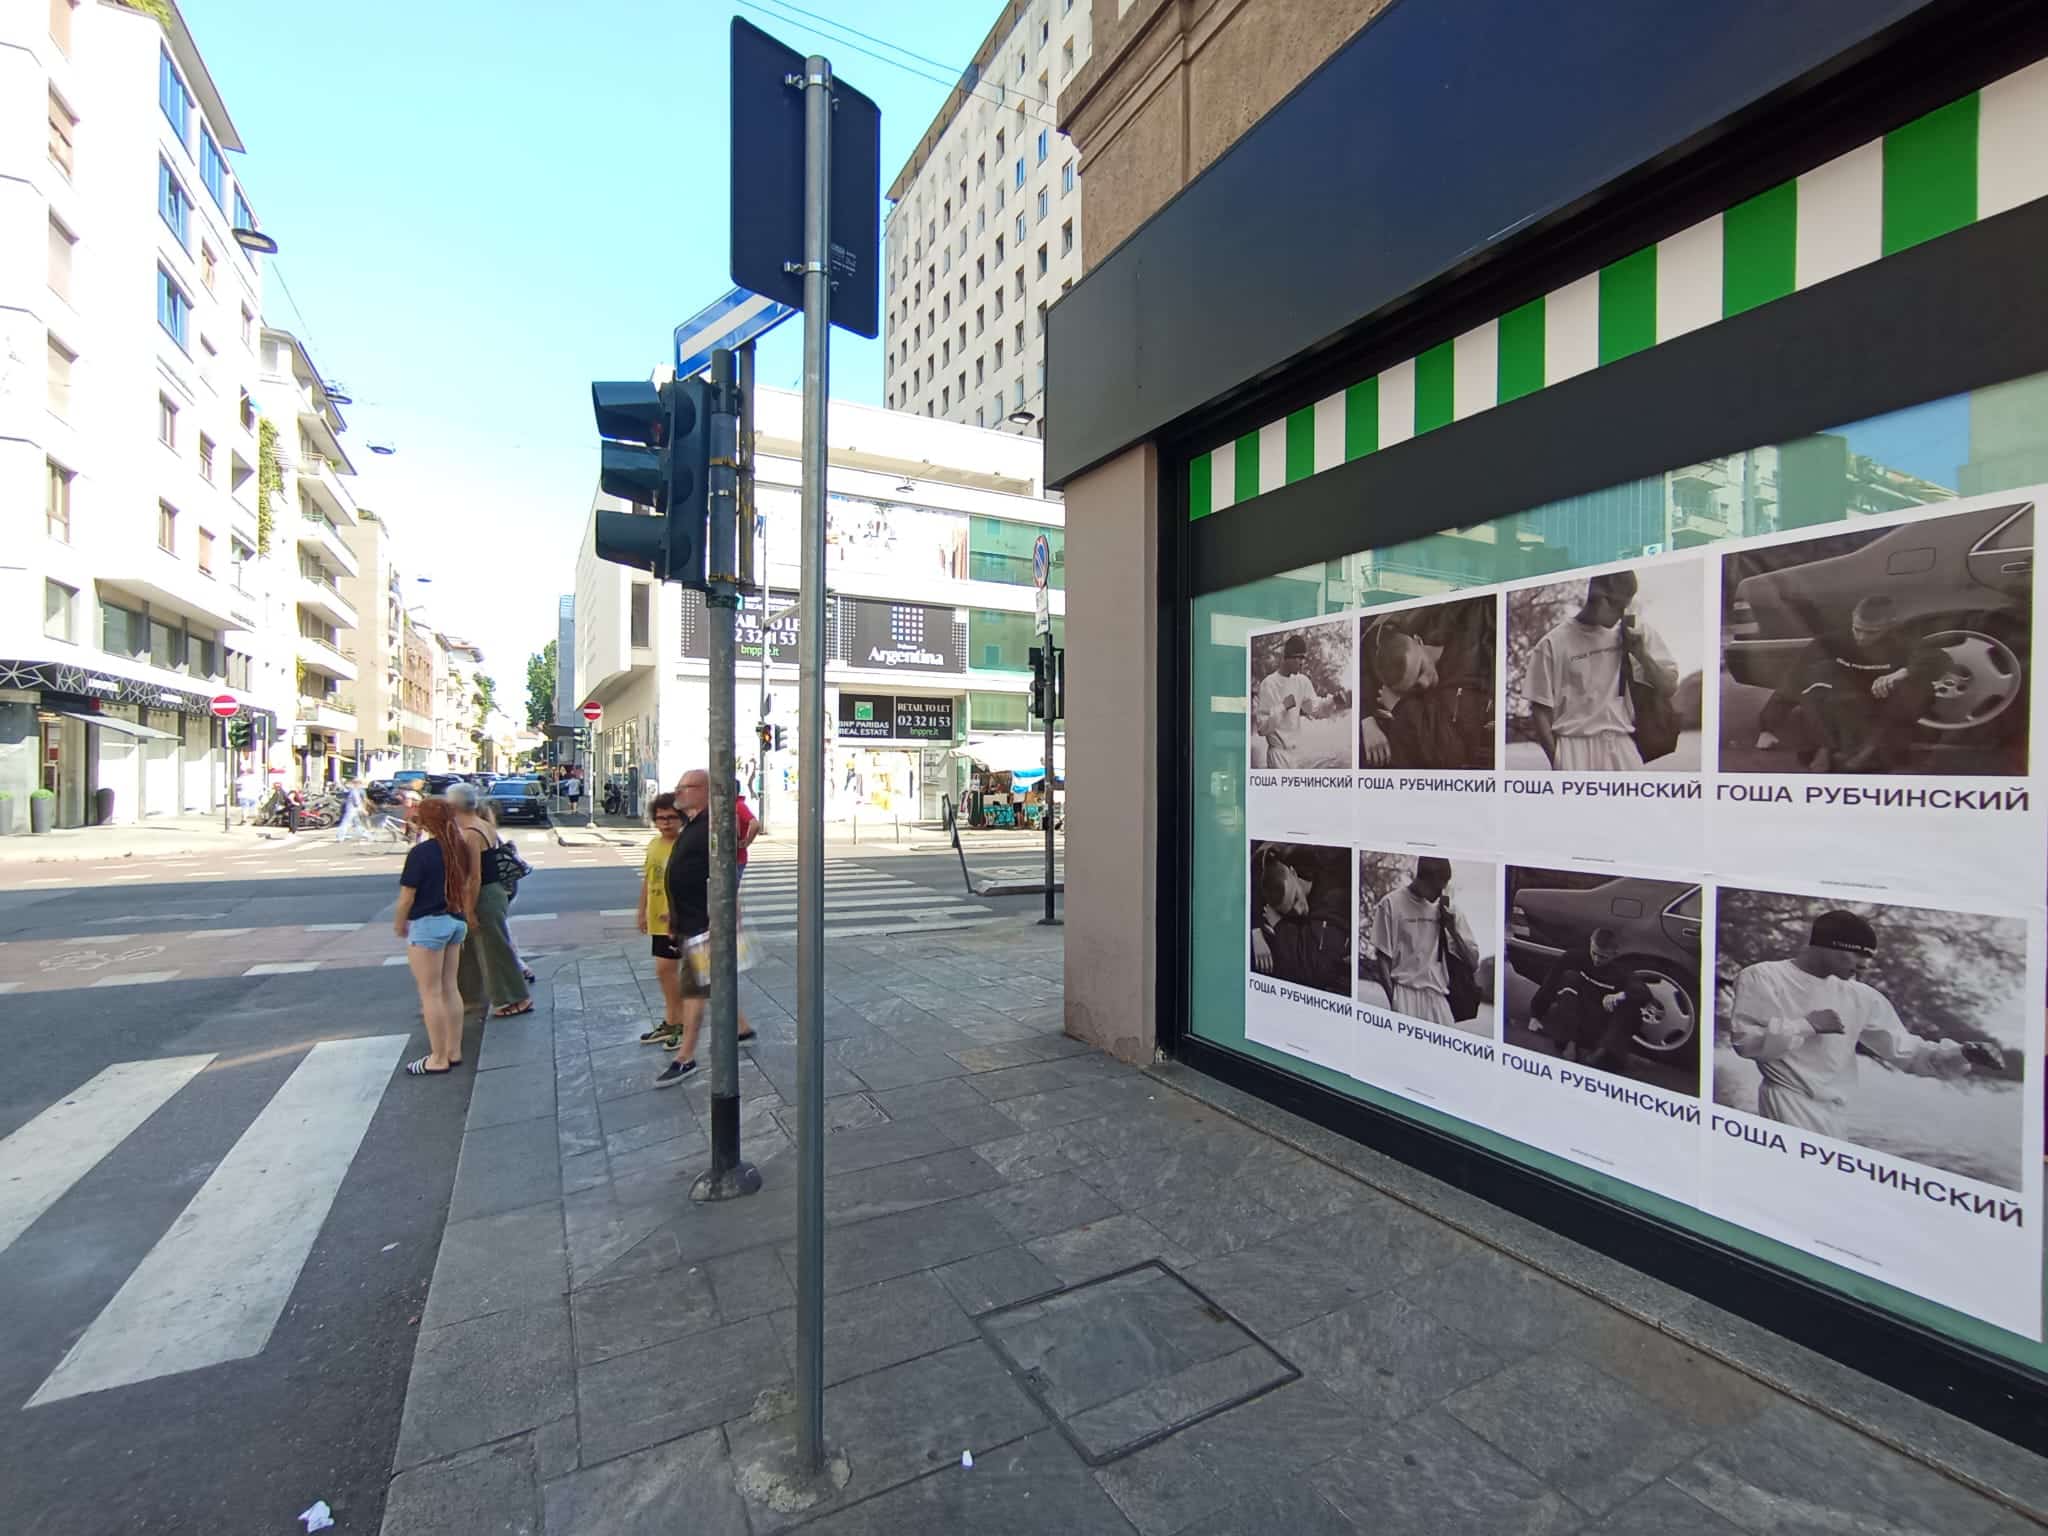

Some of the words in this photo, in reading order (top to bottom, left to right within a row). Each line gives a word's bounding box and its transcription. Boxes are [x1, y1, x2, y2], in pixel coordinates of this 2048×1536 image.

[779, 632, 797, 646] 53
[868, 646, 944, 666] Argentina
[897, 703, 924, 713] RETAIL
[924, 704, 936, 713] TO
[937, 705, 950, 713] LET
[897, 715, 912, 726] 02
[913, 716, 927, 727] 32
[929, 716, 937, 727] 11
[938, 717, 951, 727] 53
[860, 728, 888, 736] ESTATE
[1249, 776, 1278, 787] ГОША
[1281, 774, 1353, 788] РУБЧИНСКИЙ
[1358, 777, 1394, 789] ГОША
[1400, 776, 1496, 793] РУБЧИНСКИЙ
[1504, 780, 1554, 794] ГОША
[1562, 780, 1701, 799] РУБЧИНСКИЙ
[1716, 784, 1793, 803] ГОША
[1806, 787, 2030, 812] РУБЧИНСКИЙ
[1248, 978, 1277, 995] ГОША
[1280, 987, 1353, 1018] РУБЧИНСКИЙ
[1356, 1010, 1393, 1031] ГОША
[1398, 1022, 1495, 1062] РУБЧИНСКИЙ
[1502, 1053, 1553, 1080] ГОША
[1560, 1070, 1701, 1125] РУБЧИНСКИЙ
[1711, 1115, 1788, 1153] ГОША
[1800, 1142, 2024, 1228] РУБЧИНСКИЙ
